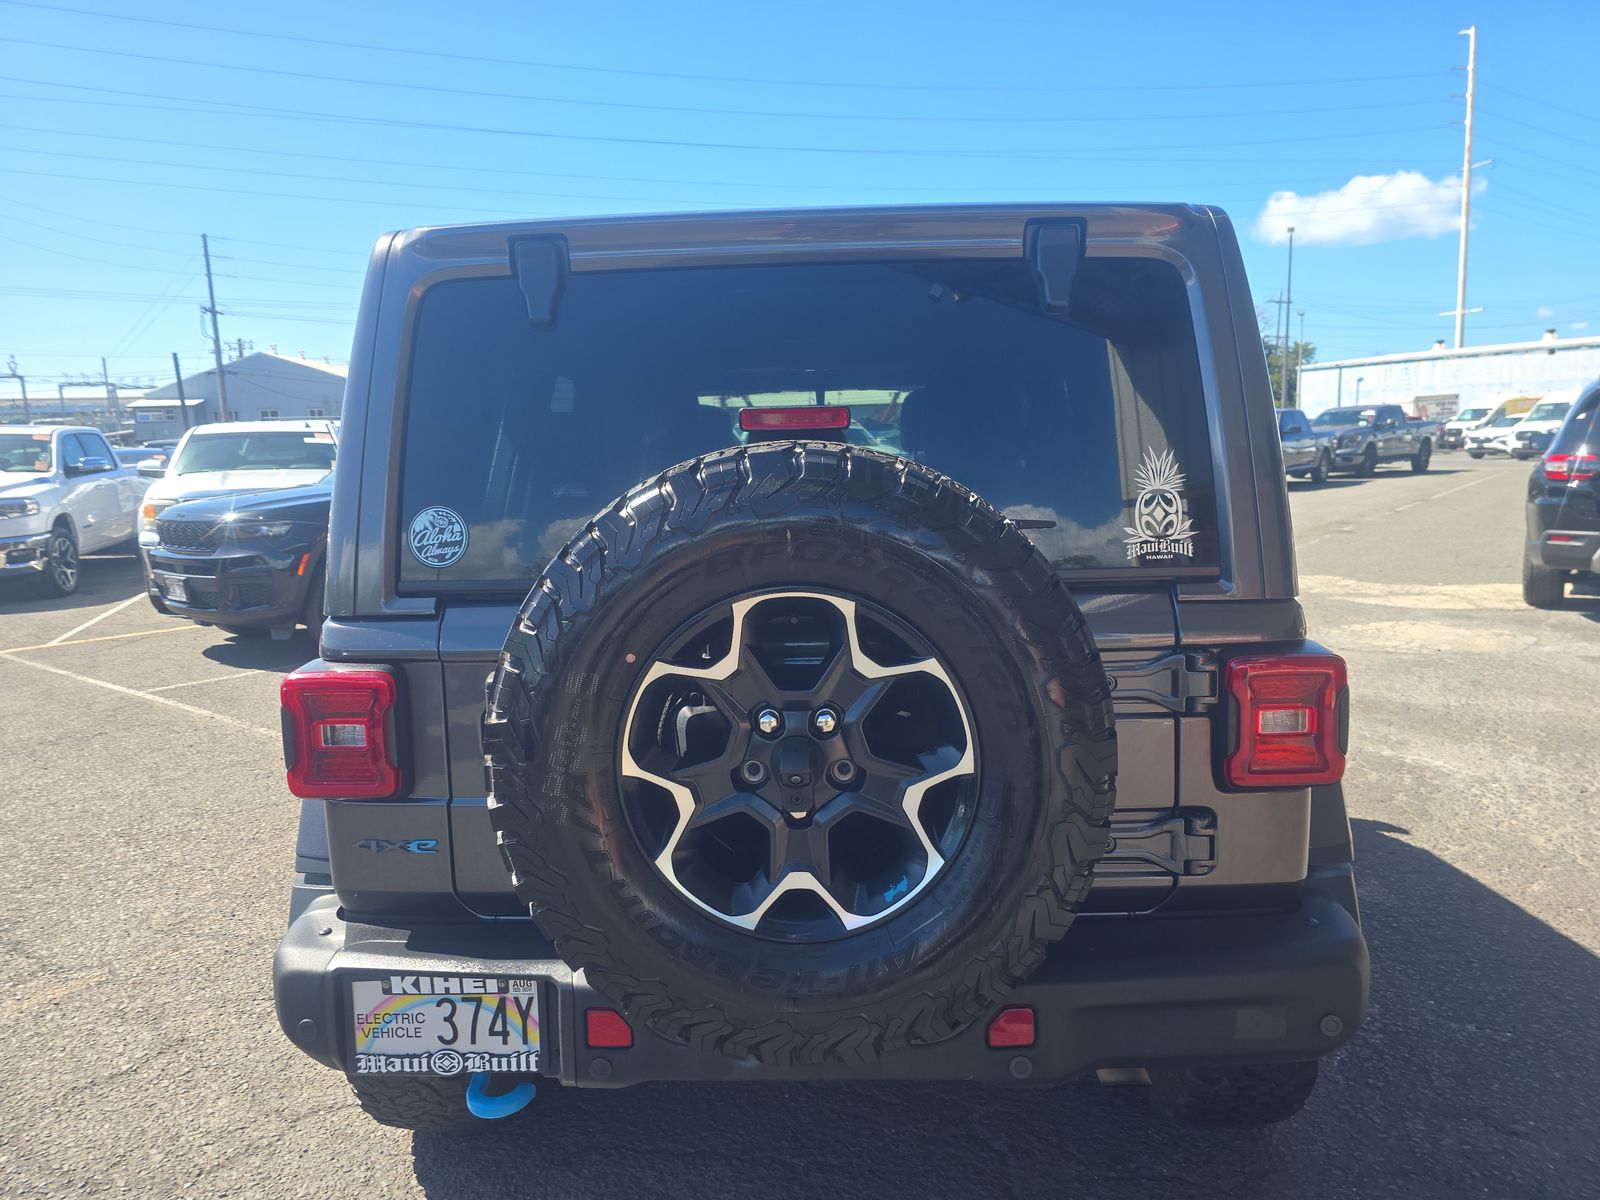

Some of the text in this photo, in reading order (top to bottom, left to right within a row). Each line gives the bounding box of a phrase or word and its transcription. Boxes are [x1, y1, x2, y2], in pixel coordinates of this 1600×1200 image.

[414, 525, 462, 547] Aloha
[389, 976, 499, 994] KIHEI
[512, 979, 533, 988] AUG
[356, 1012, 426, 1025] ELECTRIC
[435, 997, 535, 1046] 374Y
[361, 1027, 422, 1039] VEHICLE
[355, 1051, 540, 1074] Maui Built
